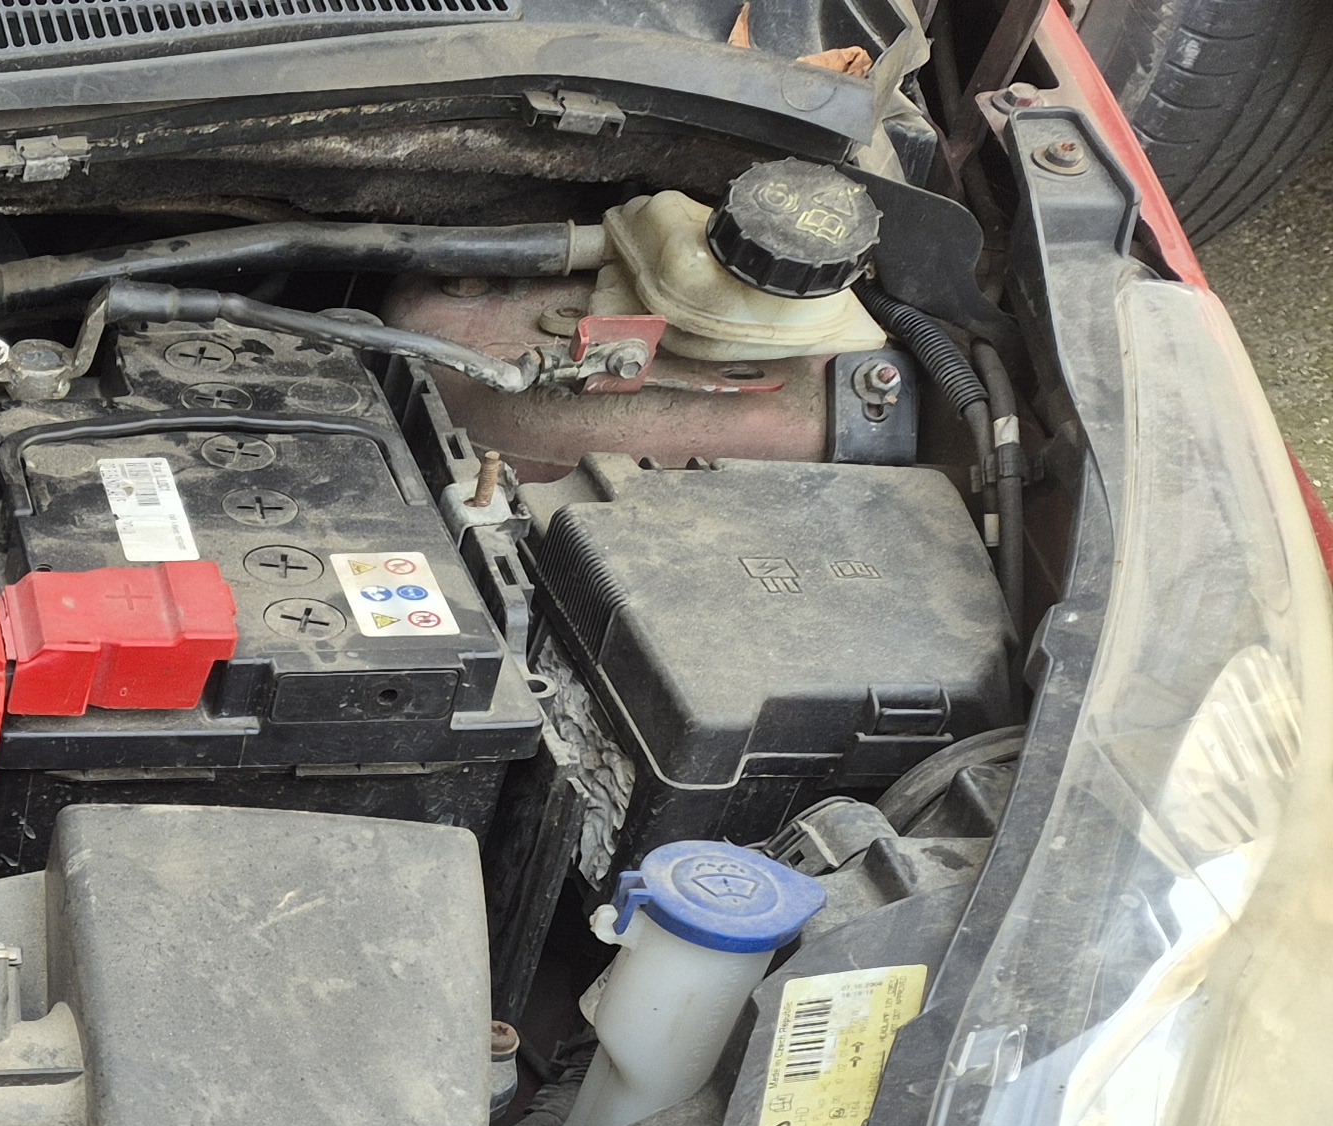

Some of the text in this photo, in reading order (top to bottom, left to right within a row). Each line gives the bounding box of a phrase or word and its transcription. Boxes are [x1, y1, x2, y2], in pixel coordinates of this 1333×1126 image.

[779, 1002, 793, 1033] Republic
[774, 1035, 786, 1058] Czech
[768, 1069, 780, 1089] Made
